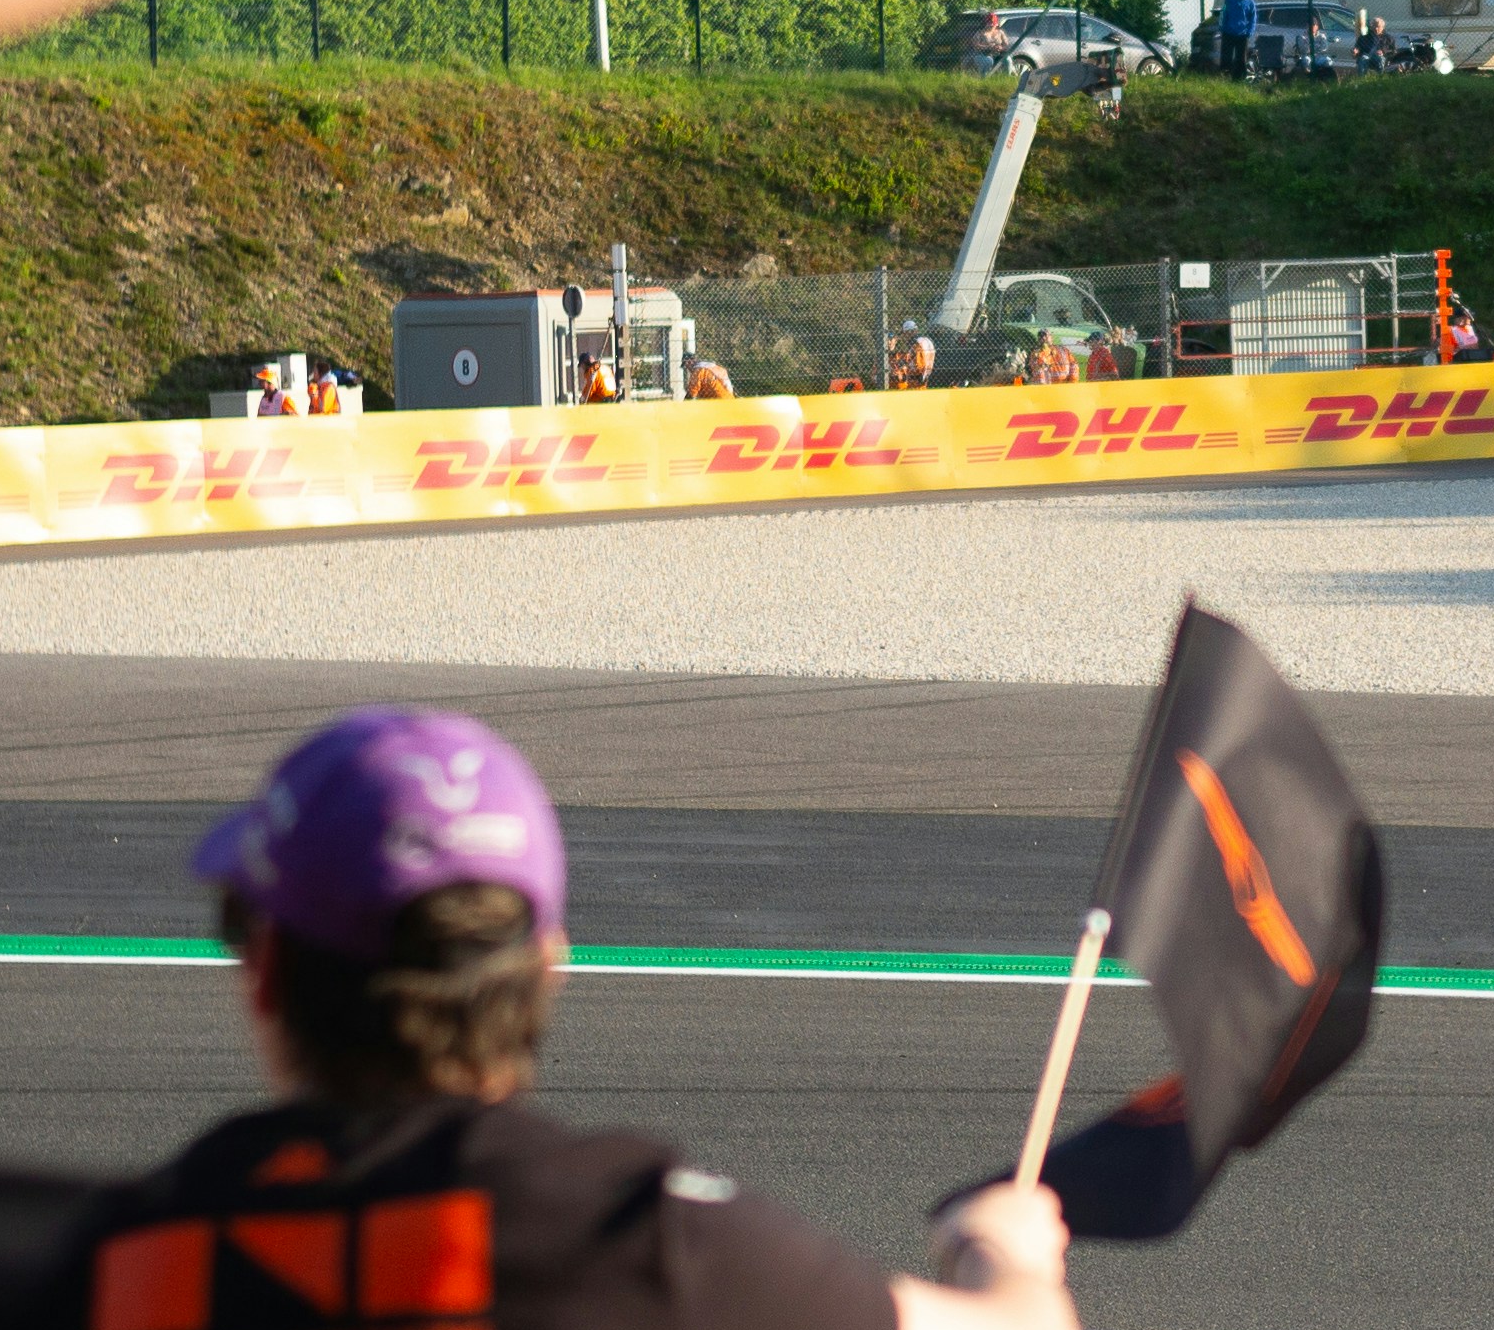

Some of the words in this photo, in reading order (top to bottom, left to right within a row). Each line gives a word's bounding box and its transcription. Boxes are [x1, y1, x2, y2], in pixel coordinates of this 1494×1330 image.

[462, 359, 470, 376] 8
[705, 418, 902, 475] DHL
[1005, 404, 1201, 461] DHL
[100, 448, 305, 507] DHL
[413, 433, 609, 491] DHL
